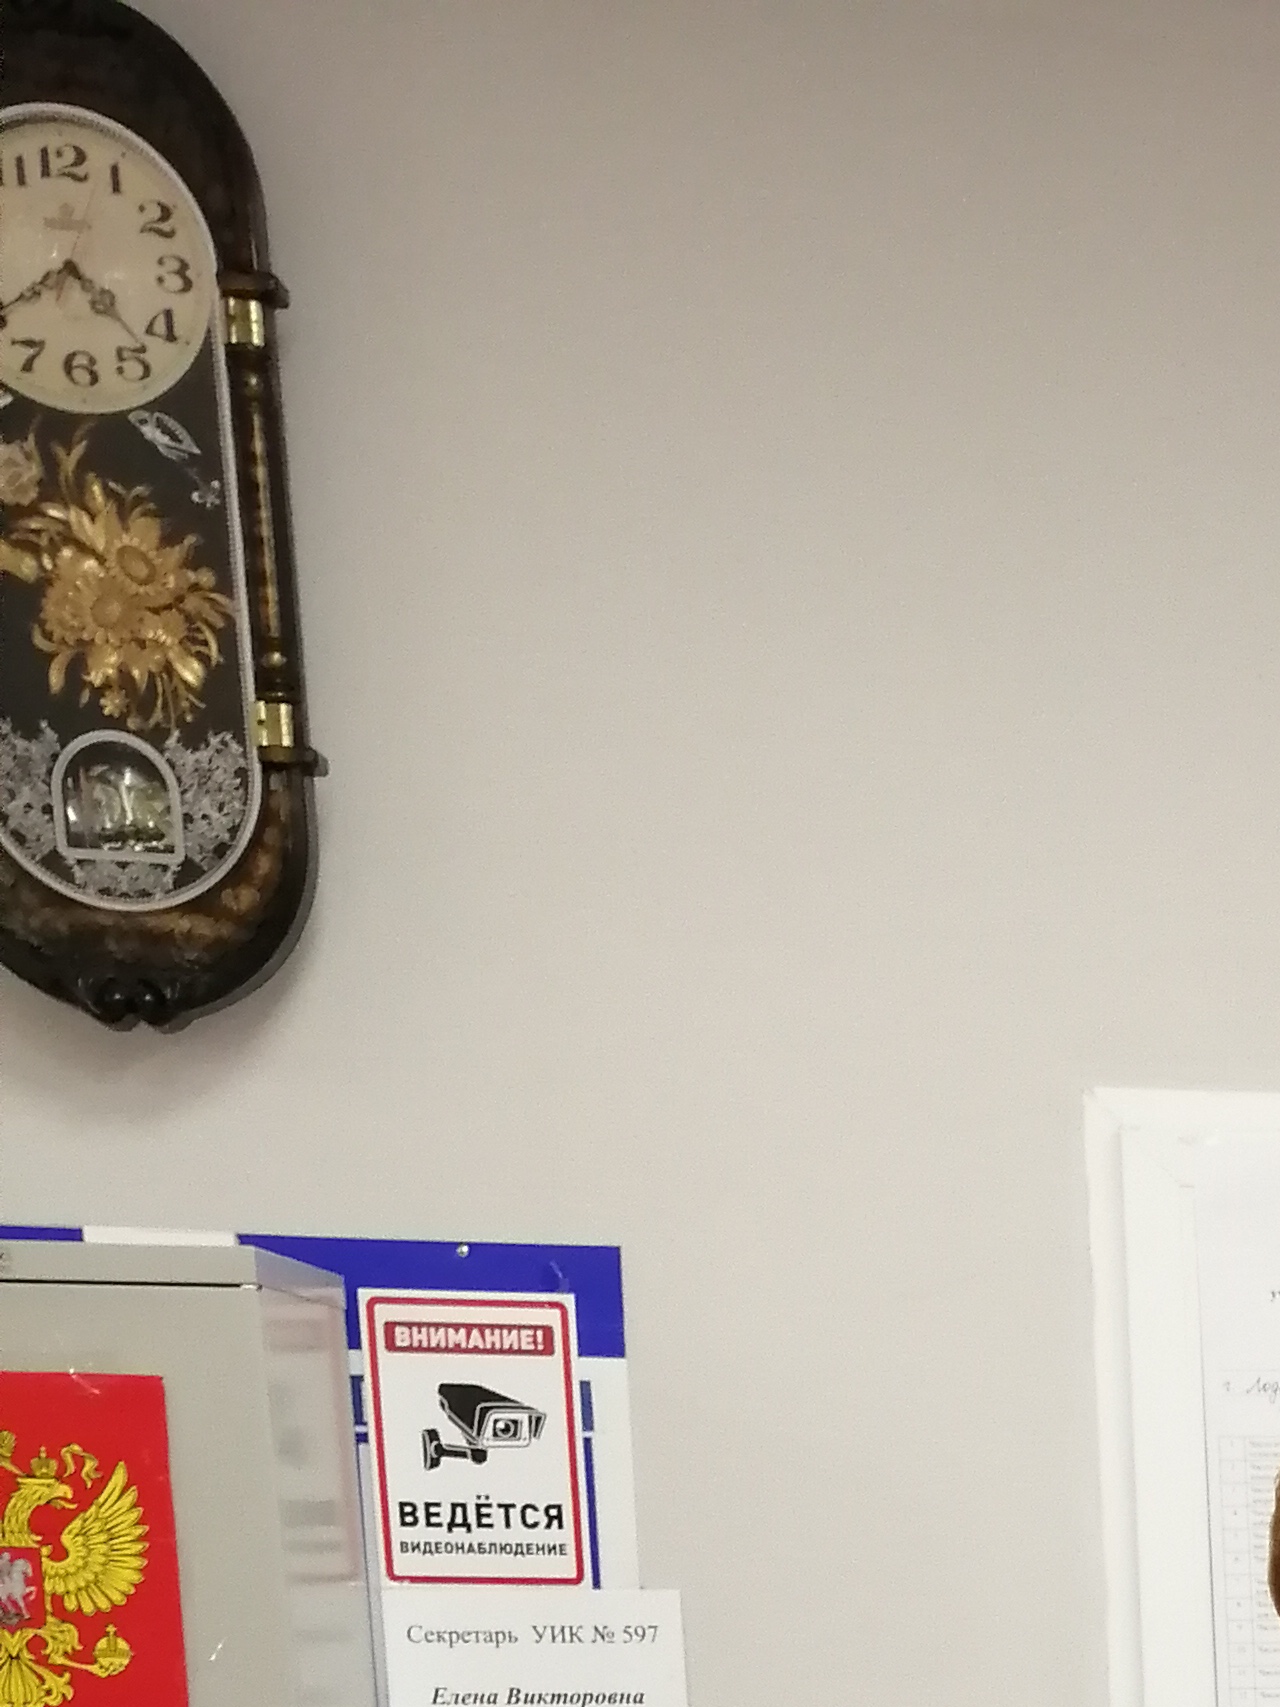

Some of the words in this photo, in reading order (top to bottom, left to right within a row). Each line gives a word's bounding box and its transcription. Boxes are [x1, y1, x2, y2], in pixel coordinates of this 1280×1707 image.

[41, 144, 89, 183] 12
[109, 162, 122, 194] 1
[138, 200, 176, 239] 2
[157, 254, 194, 294] 3
[146, 308, 178, 343] 4
[11, 337, 46, 373] 7
[63, 350, 99, 387] 6
[116, 344, 151, 381] 5
[393, 1324, 545, 1352] ВНИМАНИЕ!
[398, 1494, 565, 1534] ВЕДЁТСЯ
[400, 1540, 569, 1558] ВИДЕОНАБЛЮДЕНИЕ
[406, 1625, 519, 1648] Секретарь
[531, 1625, 584, 1645] УИК
[591, 1626, 616, 1645] №
[622, 1625, 660, 1645] 597
[431, 1686, 498, 1706] Елена
